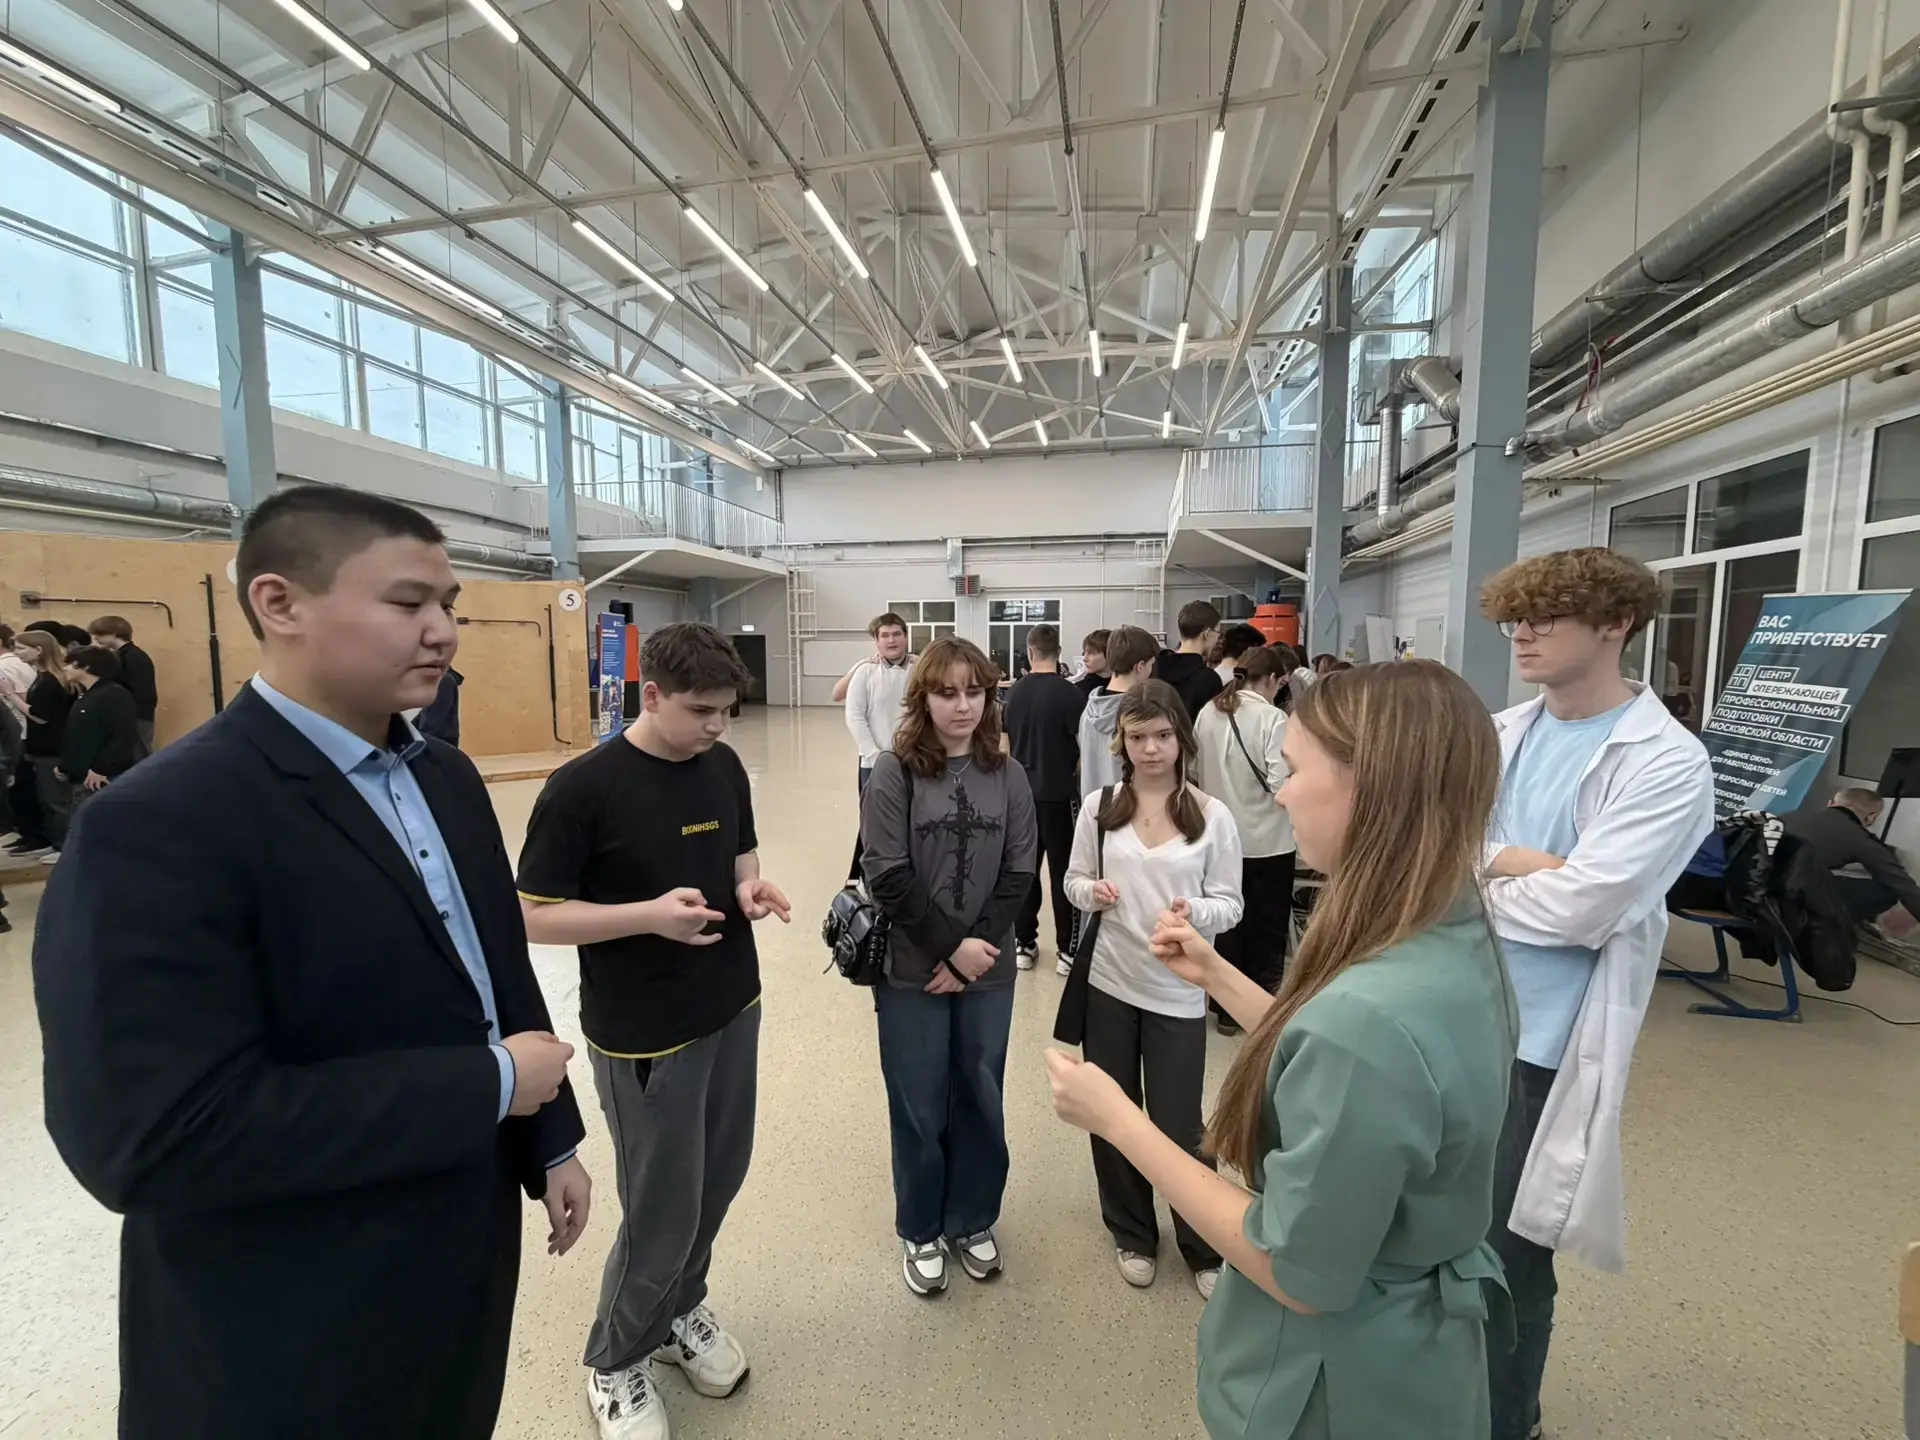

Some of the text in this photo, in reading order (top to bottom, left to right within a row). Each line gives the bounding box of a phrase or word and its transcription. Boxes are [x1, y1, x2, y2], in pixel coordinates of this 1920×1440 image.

[566, 594, 575, 606] 5
[1757, 615, 1792, 628] ВАС
[1750, 631, 1888, 649] ПРИВЕТСТВУЕТ
[1758, 669, 1792, 681] ЦЕНТР
[1752, 684, 1841, 701] ОПЕРЕЖАЮЩЕЙ
[1722, 694, 1841, 718] ПРОФЕССИОНАЛЬНОЙ
[1716, 708, 1780, 725] ПОДГОТОВКИ
[1709, 721, 1824, 748] МОСКОВСКОЙ ОБЛАСТИ
[1723, 758, 1781, 776] РАБОТОДАТЕЛЕЙ
[1718, 773, 1755, 788] ВЗРОСЛЫХ
[1760, 784, 1788, 796] ДЕТЕЙ
